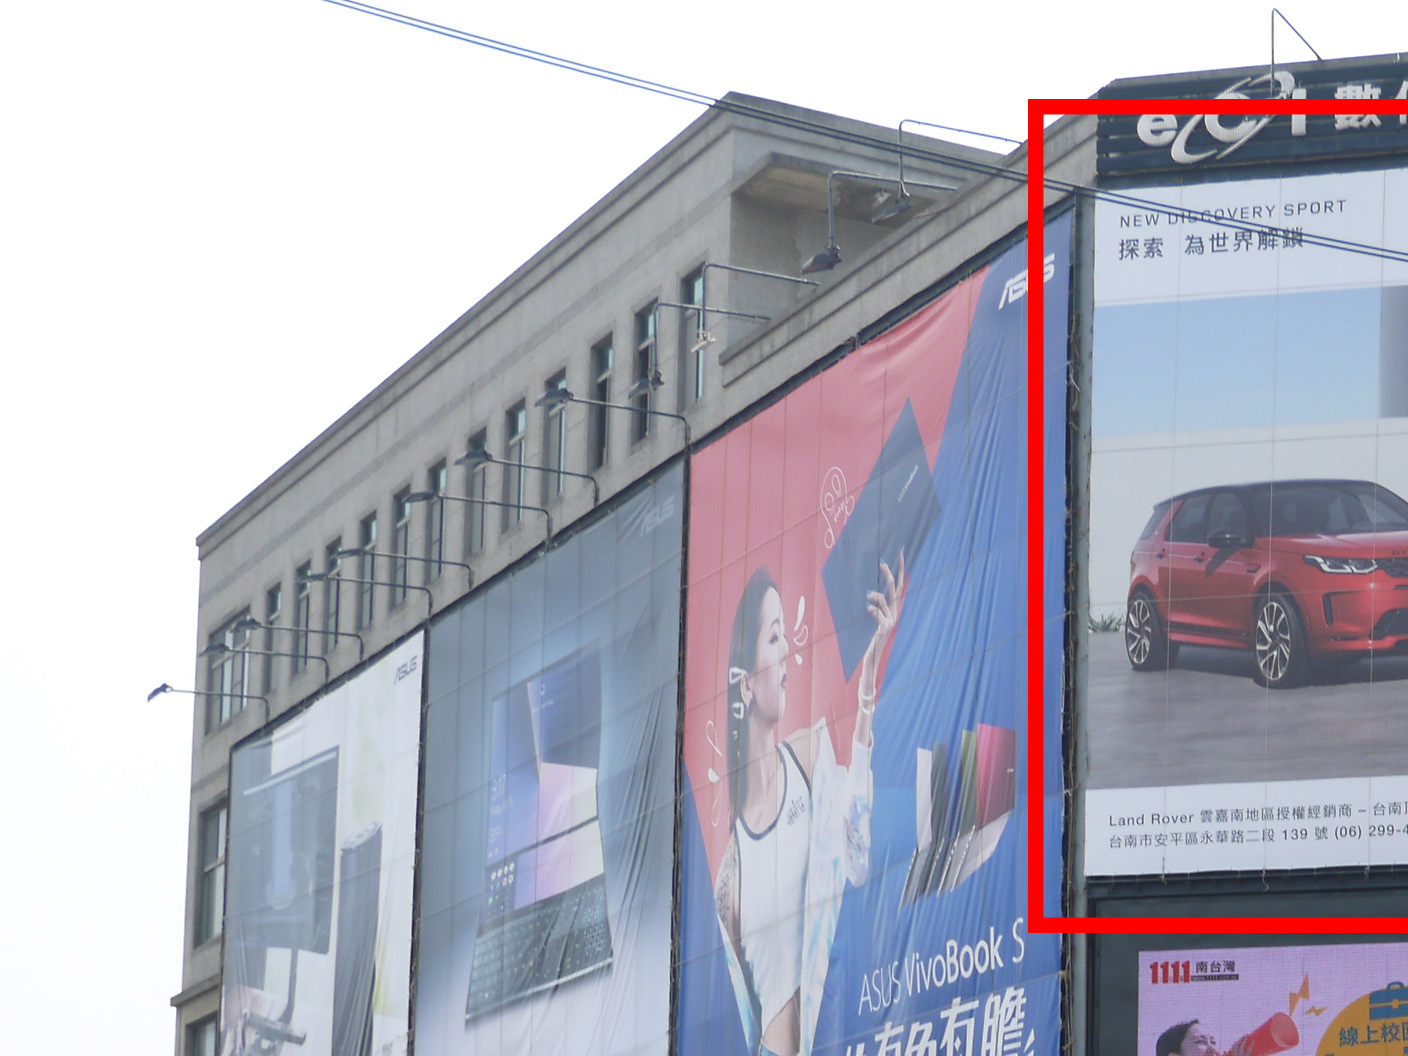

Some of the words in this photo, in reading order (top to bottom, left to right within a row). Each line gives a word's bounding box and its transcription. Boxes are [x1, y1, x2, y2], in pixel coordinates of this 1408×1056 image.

[1120, 213, 1160, 228] NEW
[1168, 205, 1275, 225] DISCOVERY
[1284, 200, 1346, 217] SPORT
[1119, 238, 1164, 260] 探索
[1185, 227, 1304, 255] 為世界解鎖
[998, 253, 1055, 310] ASS
[1108, 813, 1145, 828] Land
[1150, 811, 1194, 826] Rover
[1199, 801, 1353, 823] 雲嘉南地區授權經銷商
[1109, 828, 1276, 849] 台南市安平區永華路二段
[1281, 827, 1309, 842] 139
[1315, 828, 1329, 841] 號
[1334, 826, 1362, 841] (06)
[858, 963, 901, 1016] ASUS
[904, 935, 1004, 997] VivoBook
[1012, 916, 1026, 965] S
[1149, 960, 1191, 985] 1111
[1195, 959, 1236, 974] 南台灣
